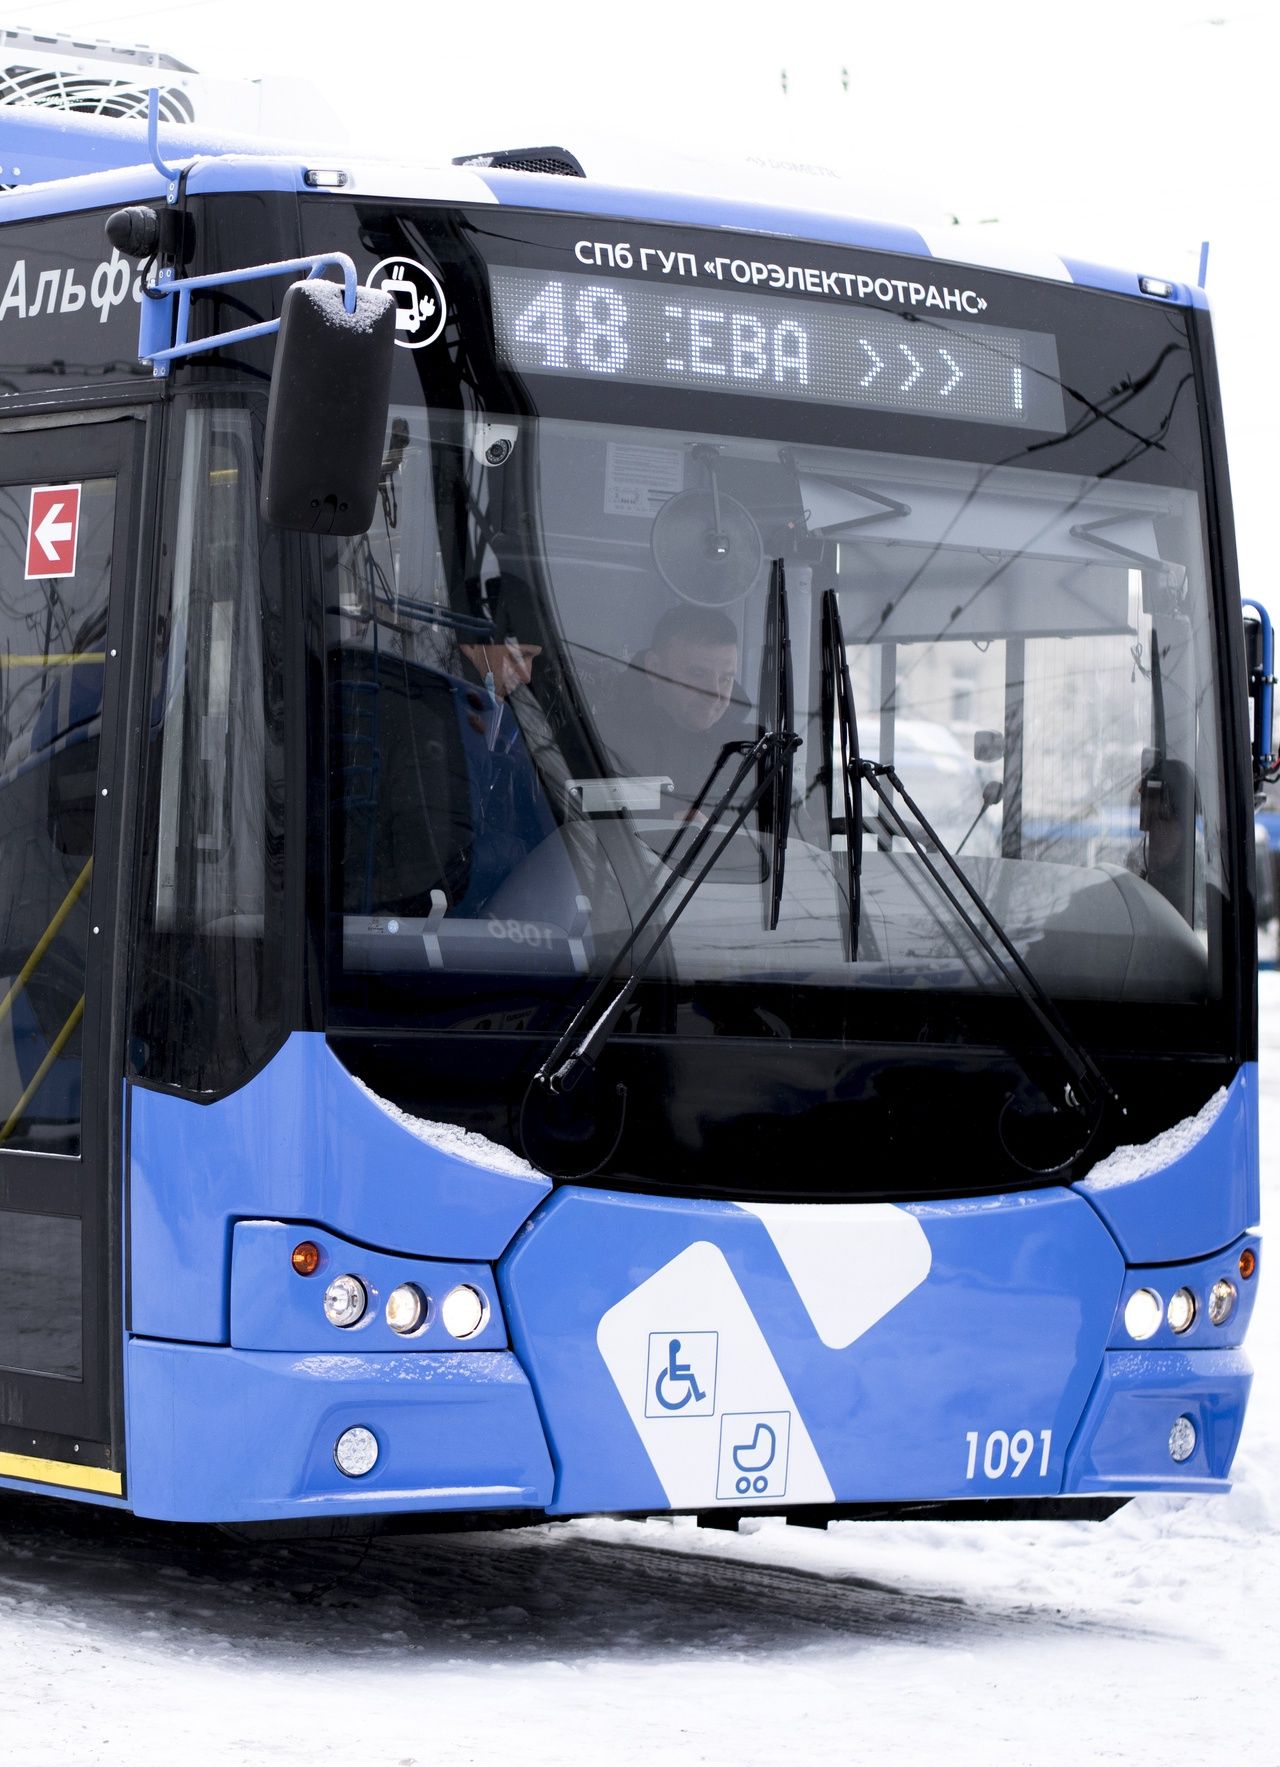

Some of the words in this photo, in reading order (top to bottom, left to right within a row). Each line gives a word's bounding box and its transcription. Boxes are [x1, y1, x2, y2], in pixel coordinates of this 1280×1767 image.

[574, 240, 633, 269] СПб
[639, 247, 697, 277] ГУП
[703, 257, 988, 314] «ГОРЭЛЕКТРОТРАНС»
[515, 281, 628, 374] 48
[966, 1429, 1052, 1479] 1091
